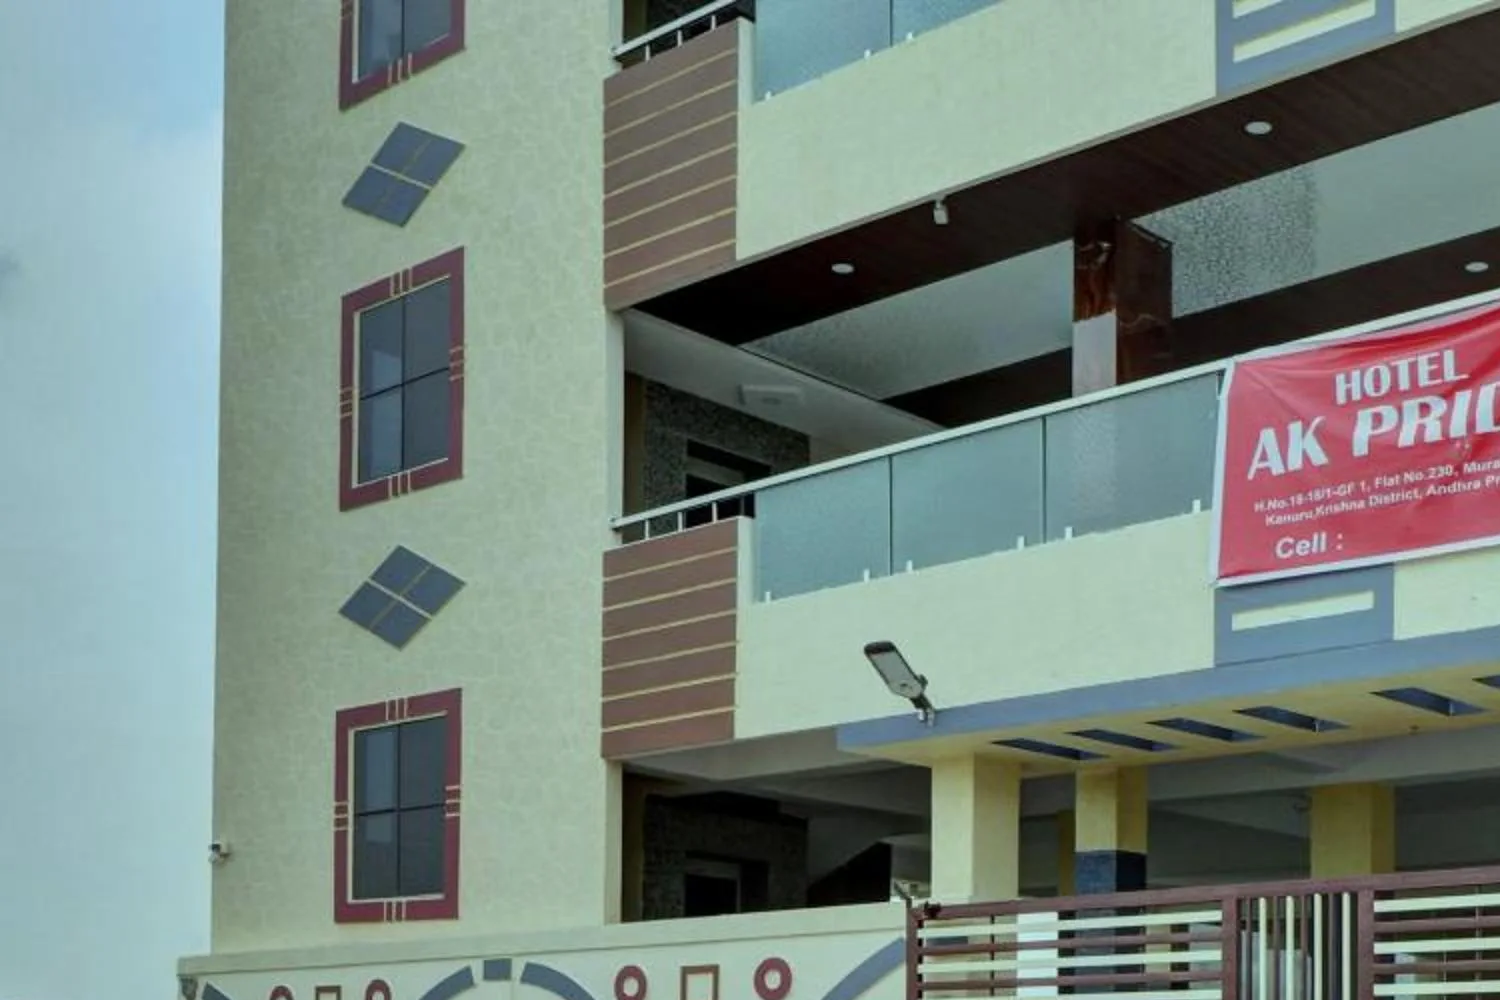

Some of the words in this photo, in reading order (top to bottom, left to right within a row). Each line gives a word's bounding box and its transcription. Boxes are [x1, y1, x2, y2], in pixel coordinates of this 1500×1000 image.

[1336, 349, 1470, 404] HOTEL
[1247, 416, 1329, 480] AK
[1375, 473, 1400, 488] Flat
[1426, 477, 1481, 497] Andhra
